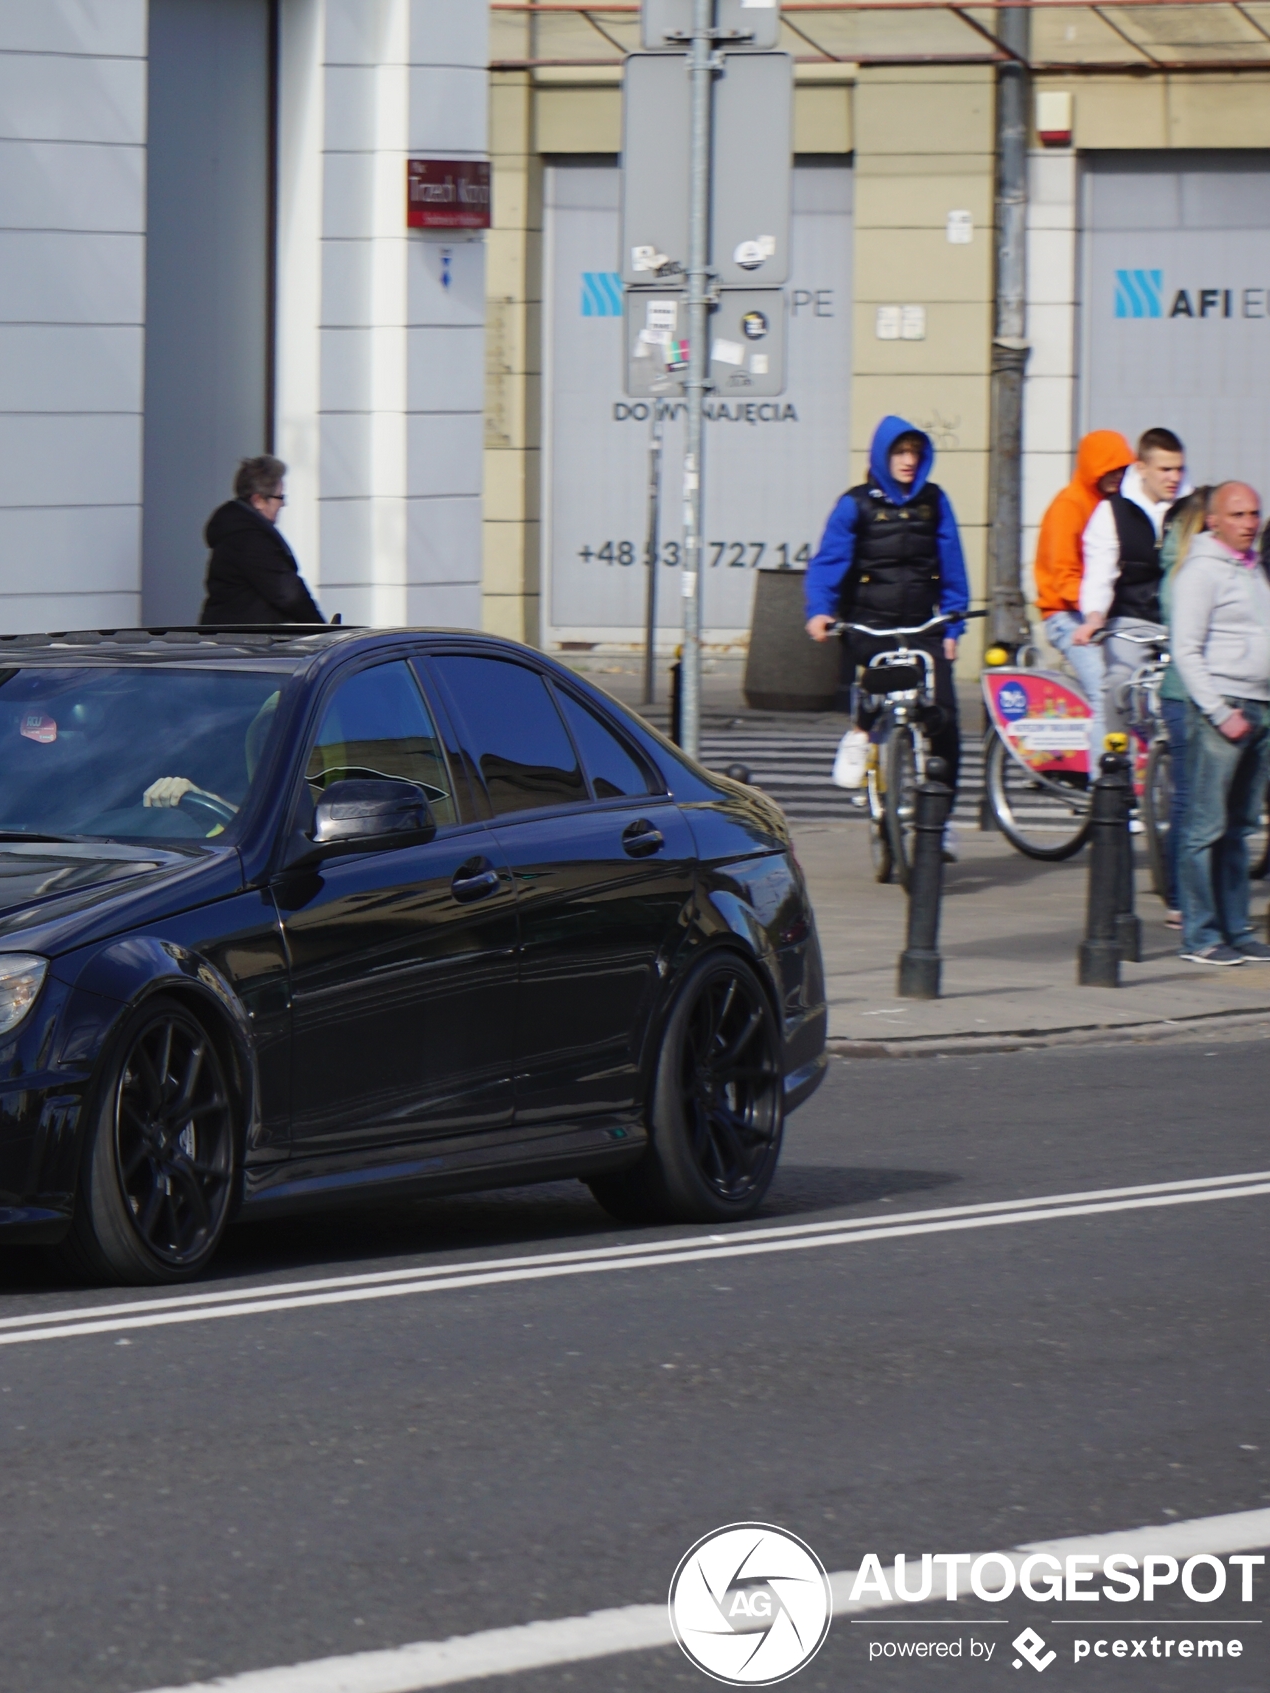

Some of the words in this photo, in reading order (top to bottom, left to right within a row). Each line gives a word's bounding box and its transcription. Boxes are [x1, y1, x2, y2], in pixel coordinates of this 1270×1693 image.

[792, 289, 834, 317] PE
[1169, 289, 1231, 318] AFI
[1242, 289, 1270, 318] E
[613, 403, 649, 421] DO
[578, 541, 634, 566] +48
[708, 541, 766, 567] 727
[776, 543, 813, 568] 14
